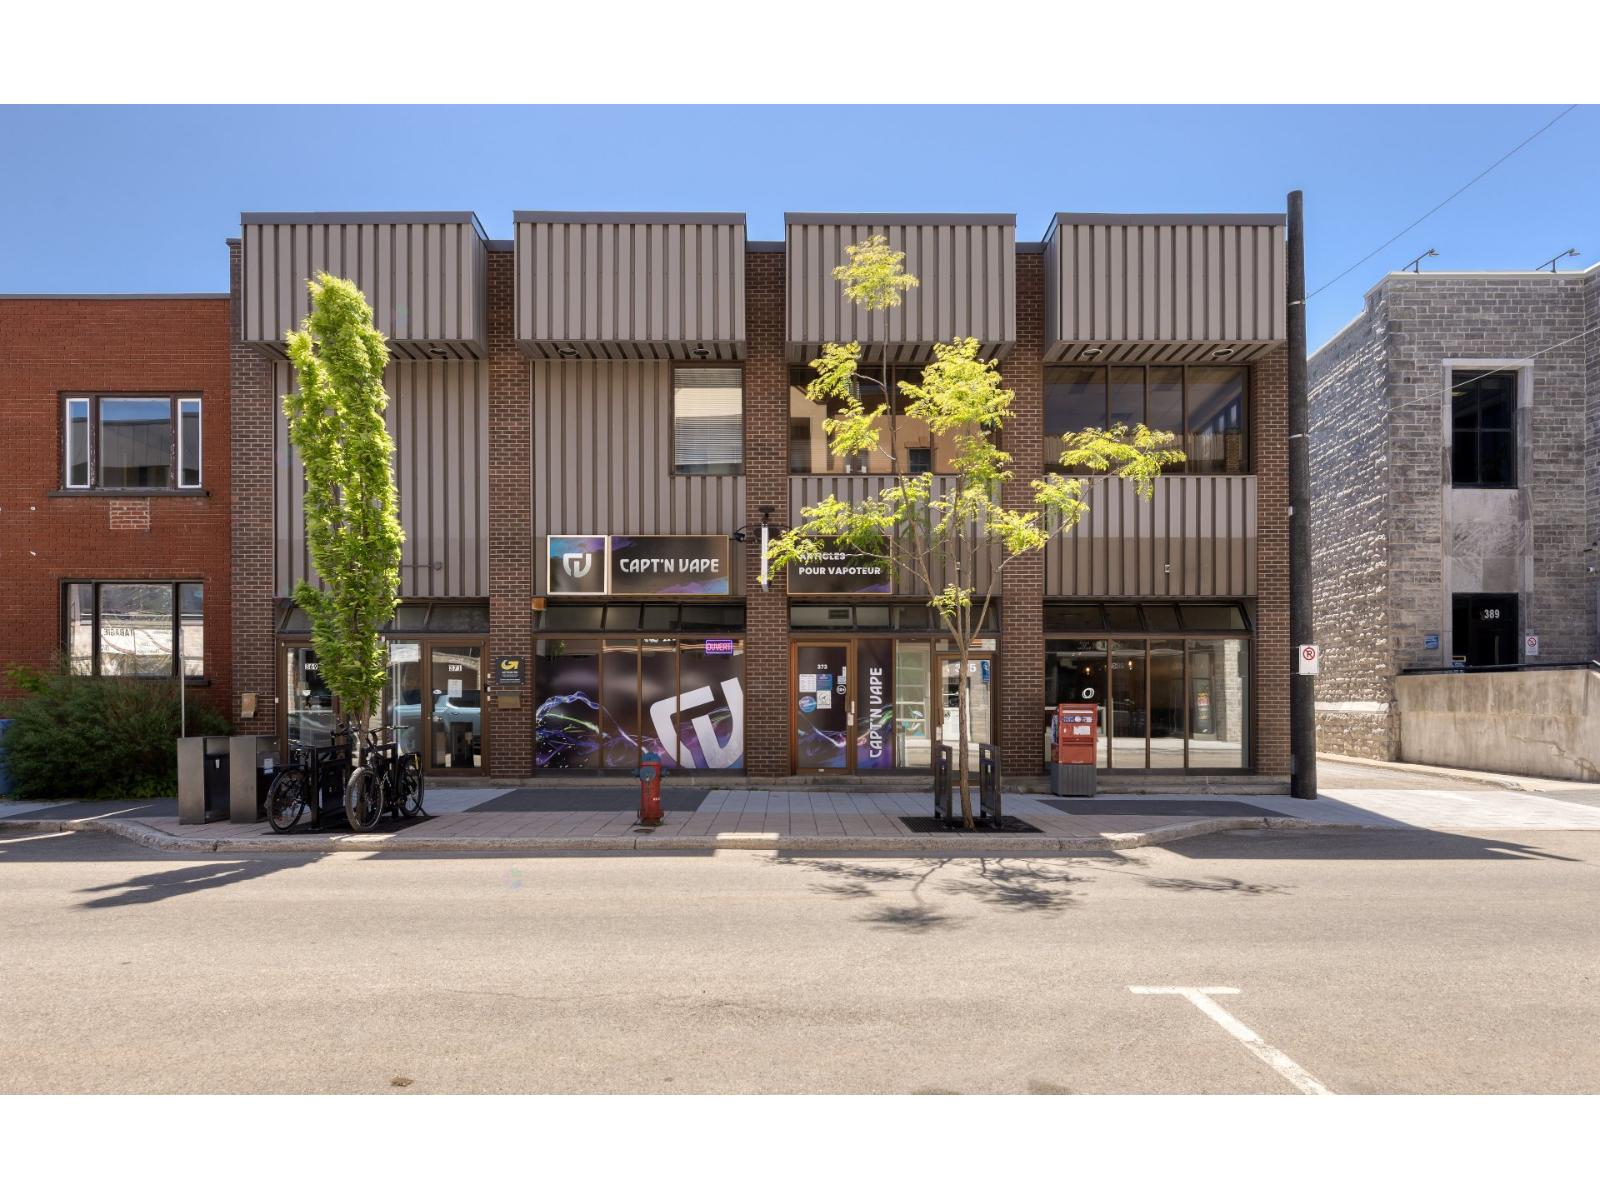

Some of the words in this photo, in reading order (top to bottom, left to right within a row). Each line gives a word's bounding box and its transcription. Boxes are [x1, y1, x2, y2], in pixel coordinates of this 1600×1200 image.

[620, 558, 674, 573] CAPT'N
[679, 558, 719, 573] VAPE
[799, 567, 826, 575] POUR
[828, 567, 881, 575] VAPOTEUR
[1484, 609, 1500, 619] 389
[706, 643, 731, 651] OUVERT
[954, 663, 977, 673] 35
[869, 667, 883, 705] VAPE
[869, 709, 883, 758] CAPT'N
